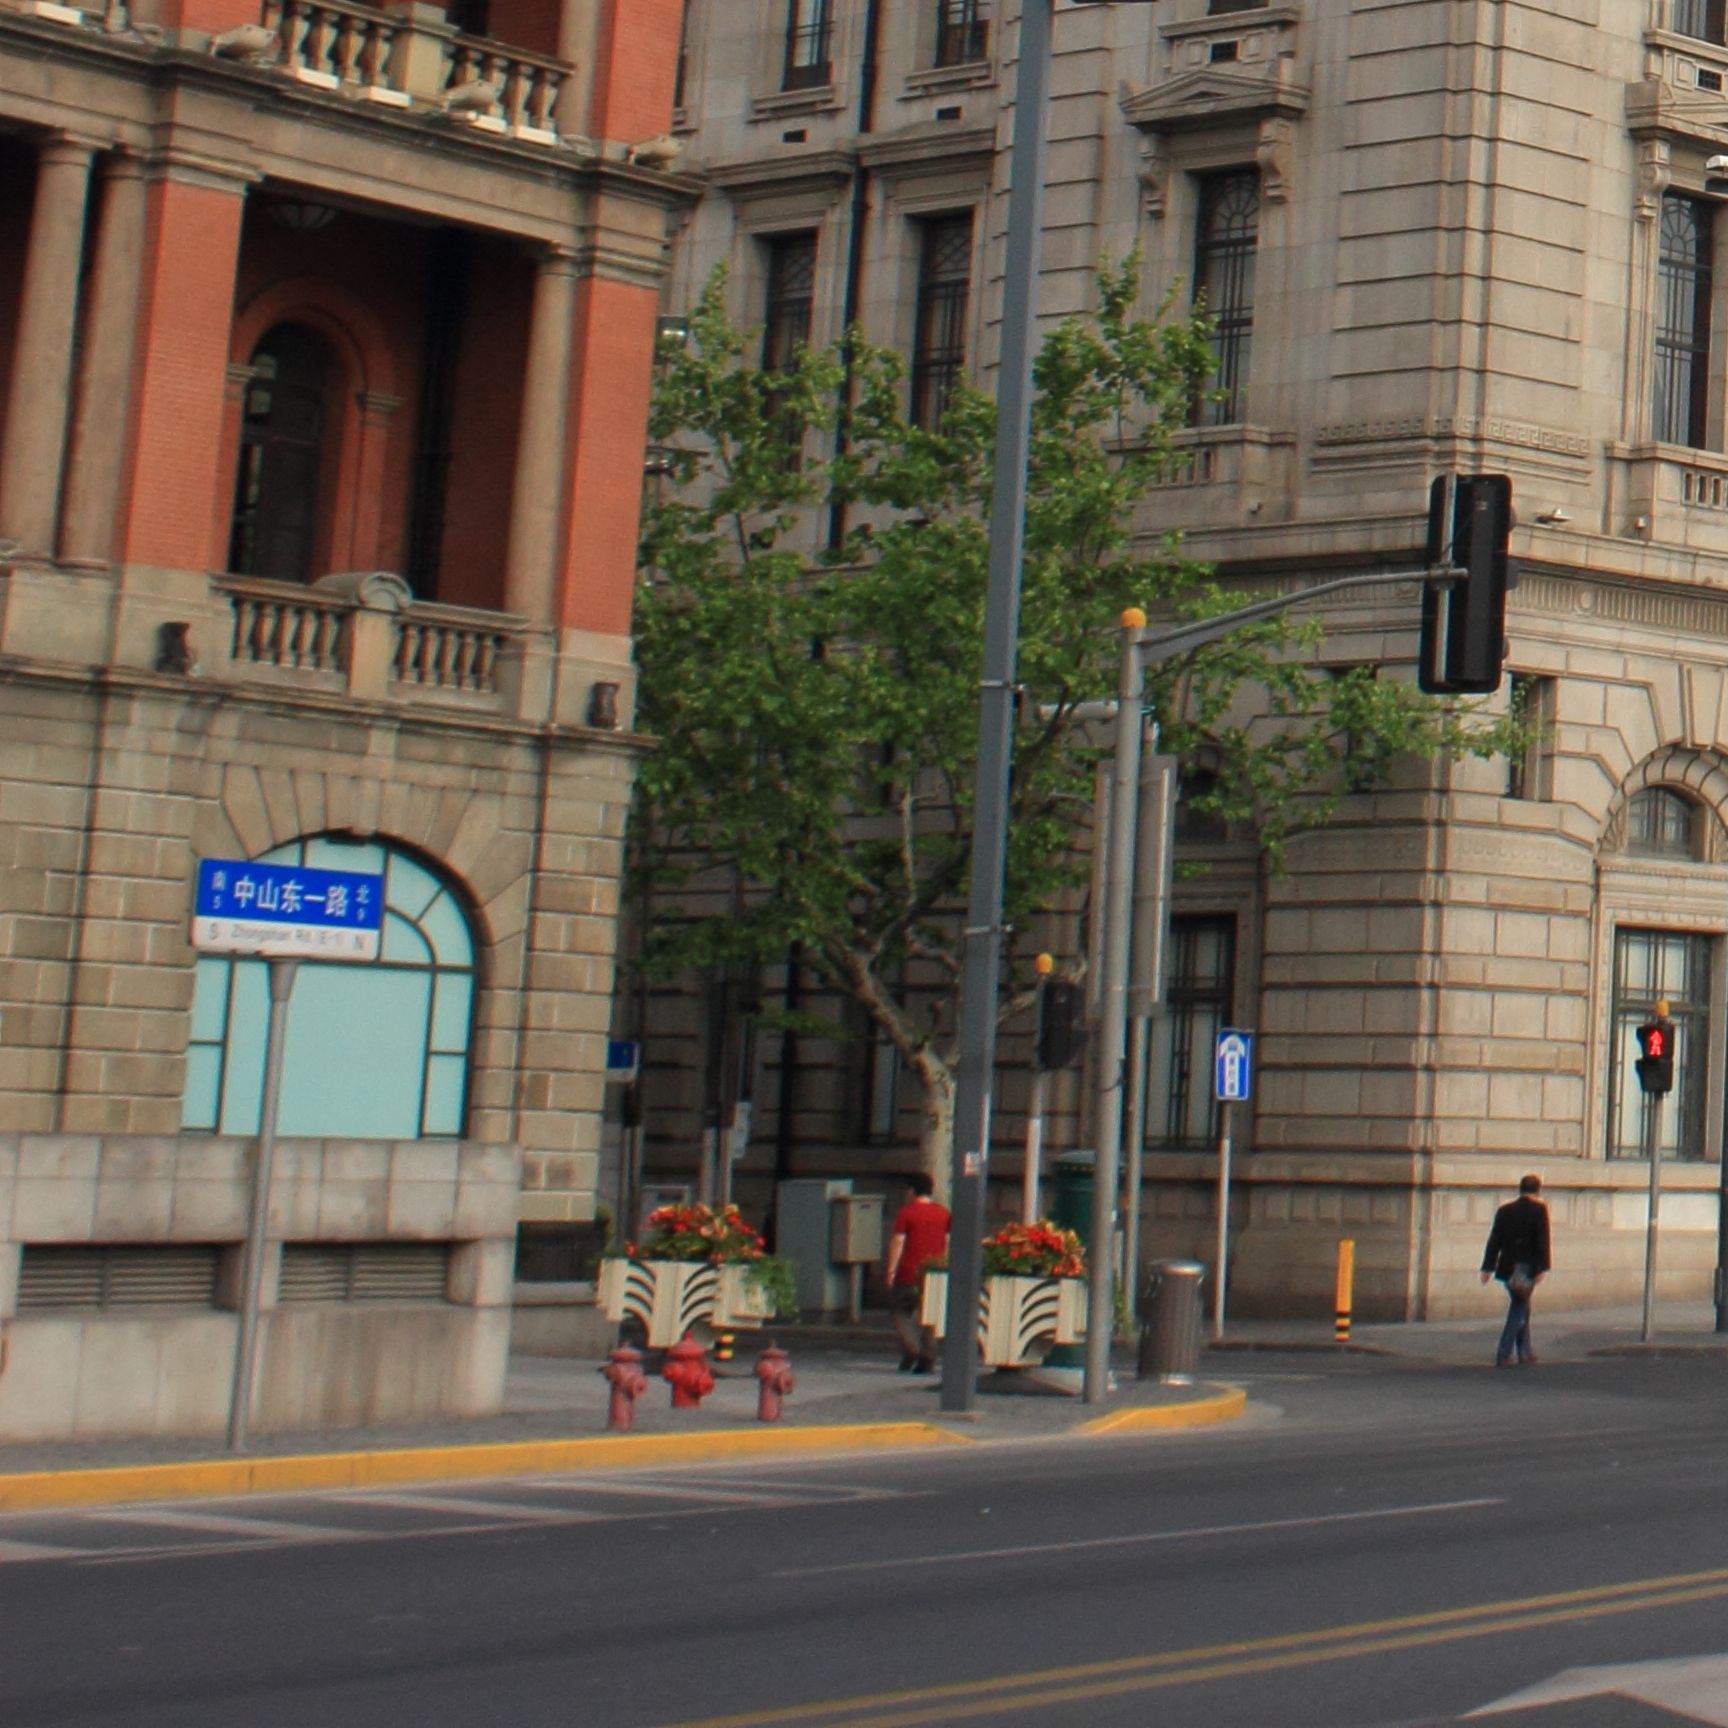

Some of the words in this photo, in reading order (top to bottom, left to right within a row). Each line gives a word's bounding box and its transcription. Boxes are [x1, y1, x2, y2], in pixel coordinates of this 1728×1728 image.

[233, 874, 348, 917] 中山东一路
[356, 885, 369, 904] 北
[208, 923, 218, 940] S
